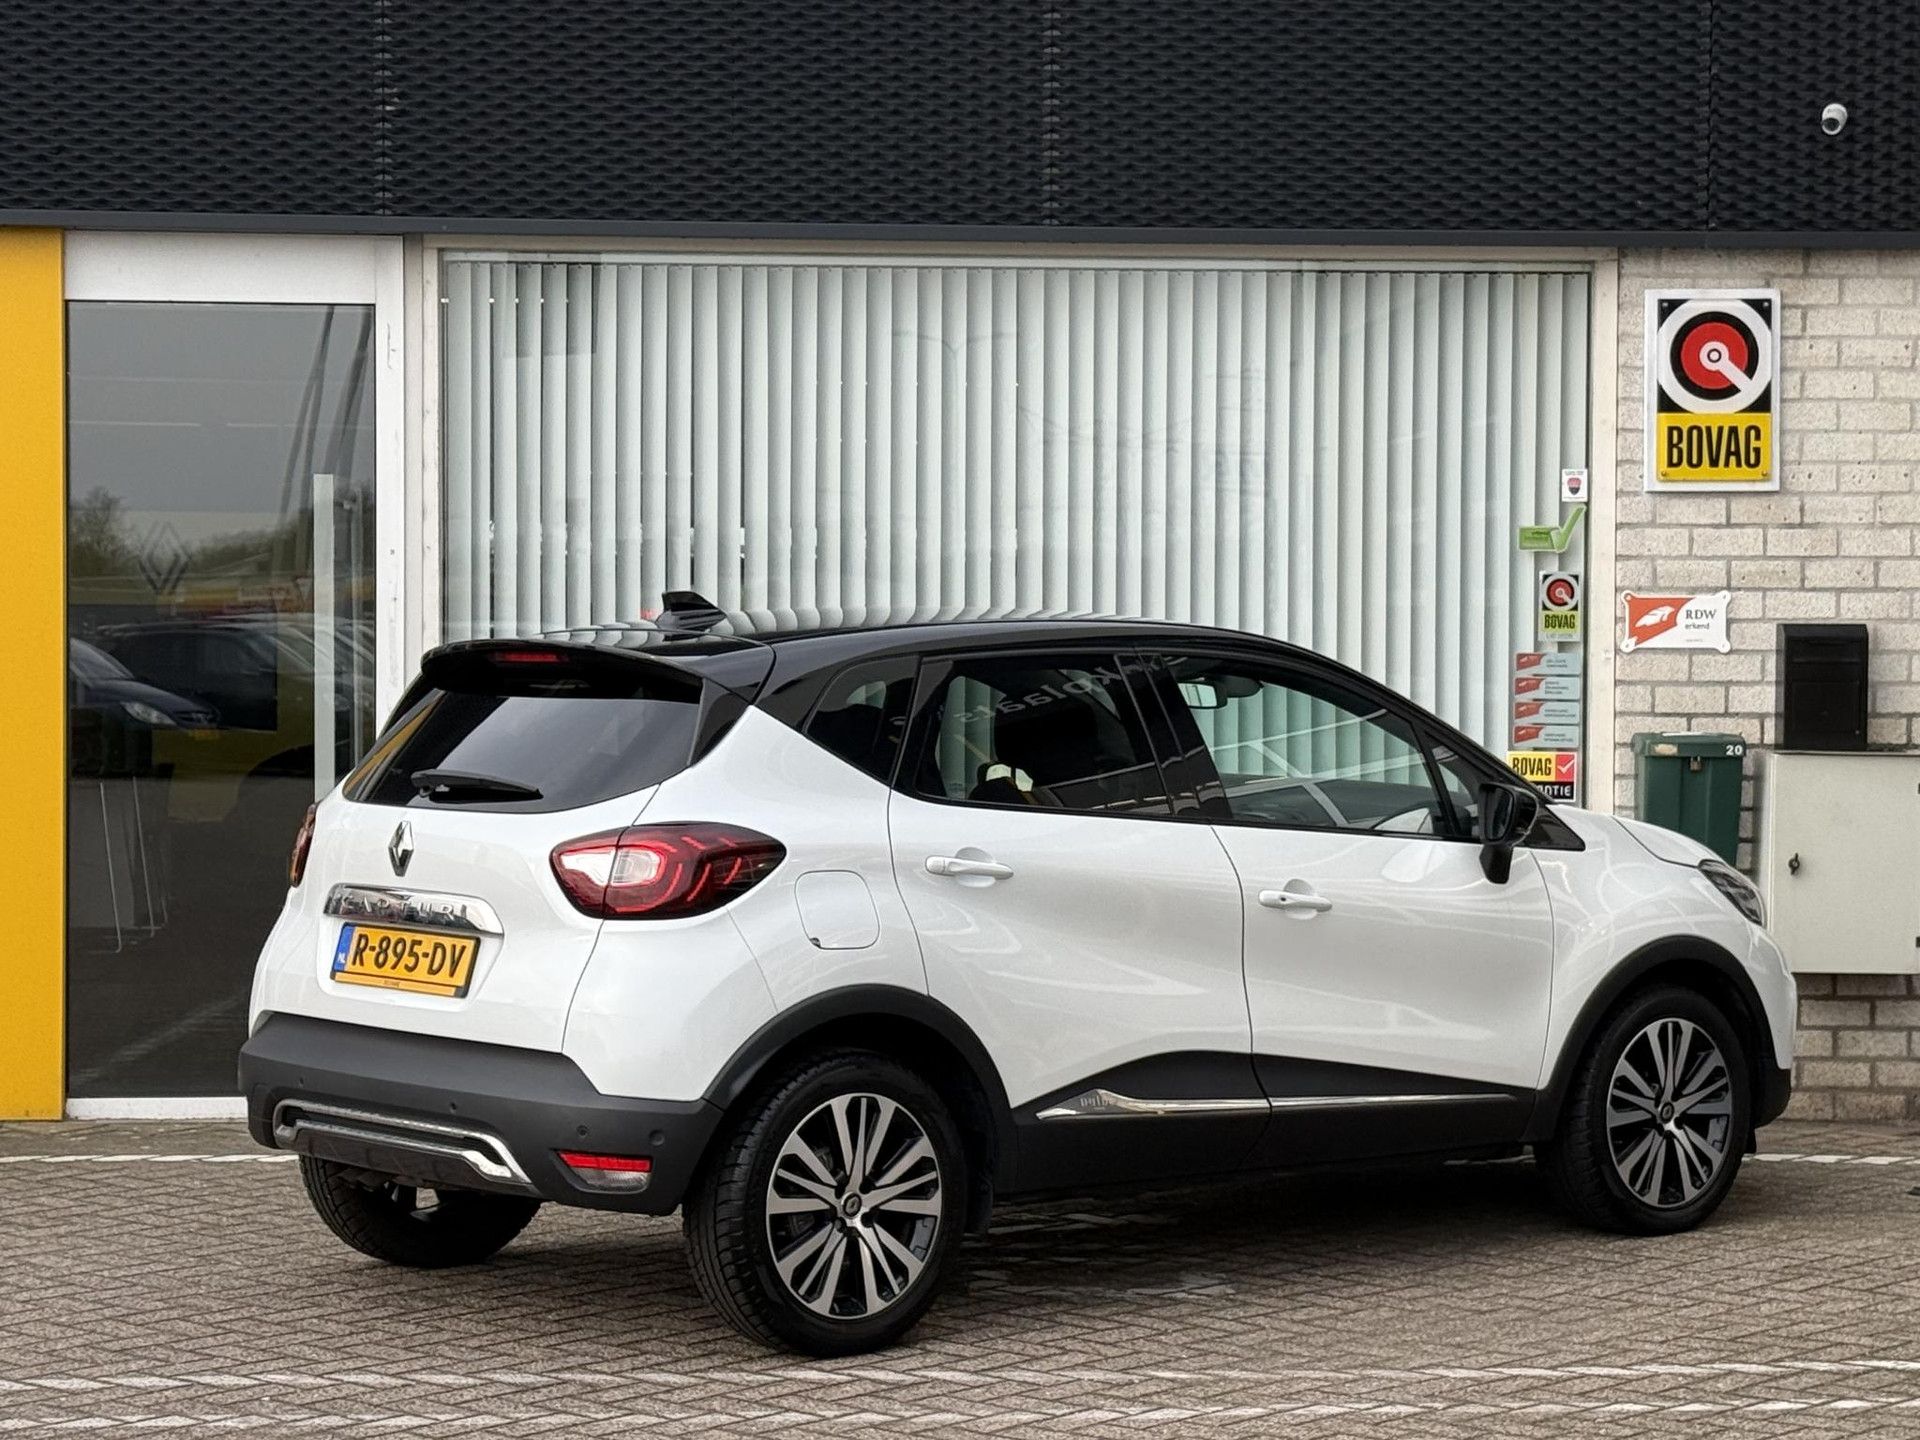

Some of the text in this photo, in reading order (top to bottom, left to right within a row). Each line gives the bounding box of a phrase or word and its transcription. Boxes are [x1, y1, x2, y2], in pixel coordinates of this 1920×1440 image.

[1666, 424, 1762, 469] BOVAG
[1544, 614, 1576, 629] BOVAG
[1685, 609, 1717, 620] RDW
[1725, 744, 1743, 756] 20
[1512, 757, 1552, 776] BOVAG
[351, 933, 467, 978] R-895-DV
